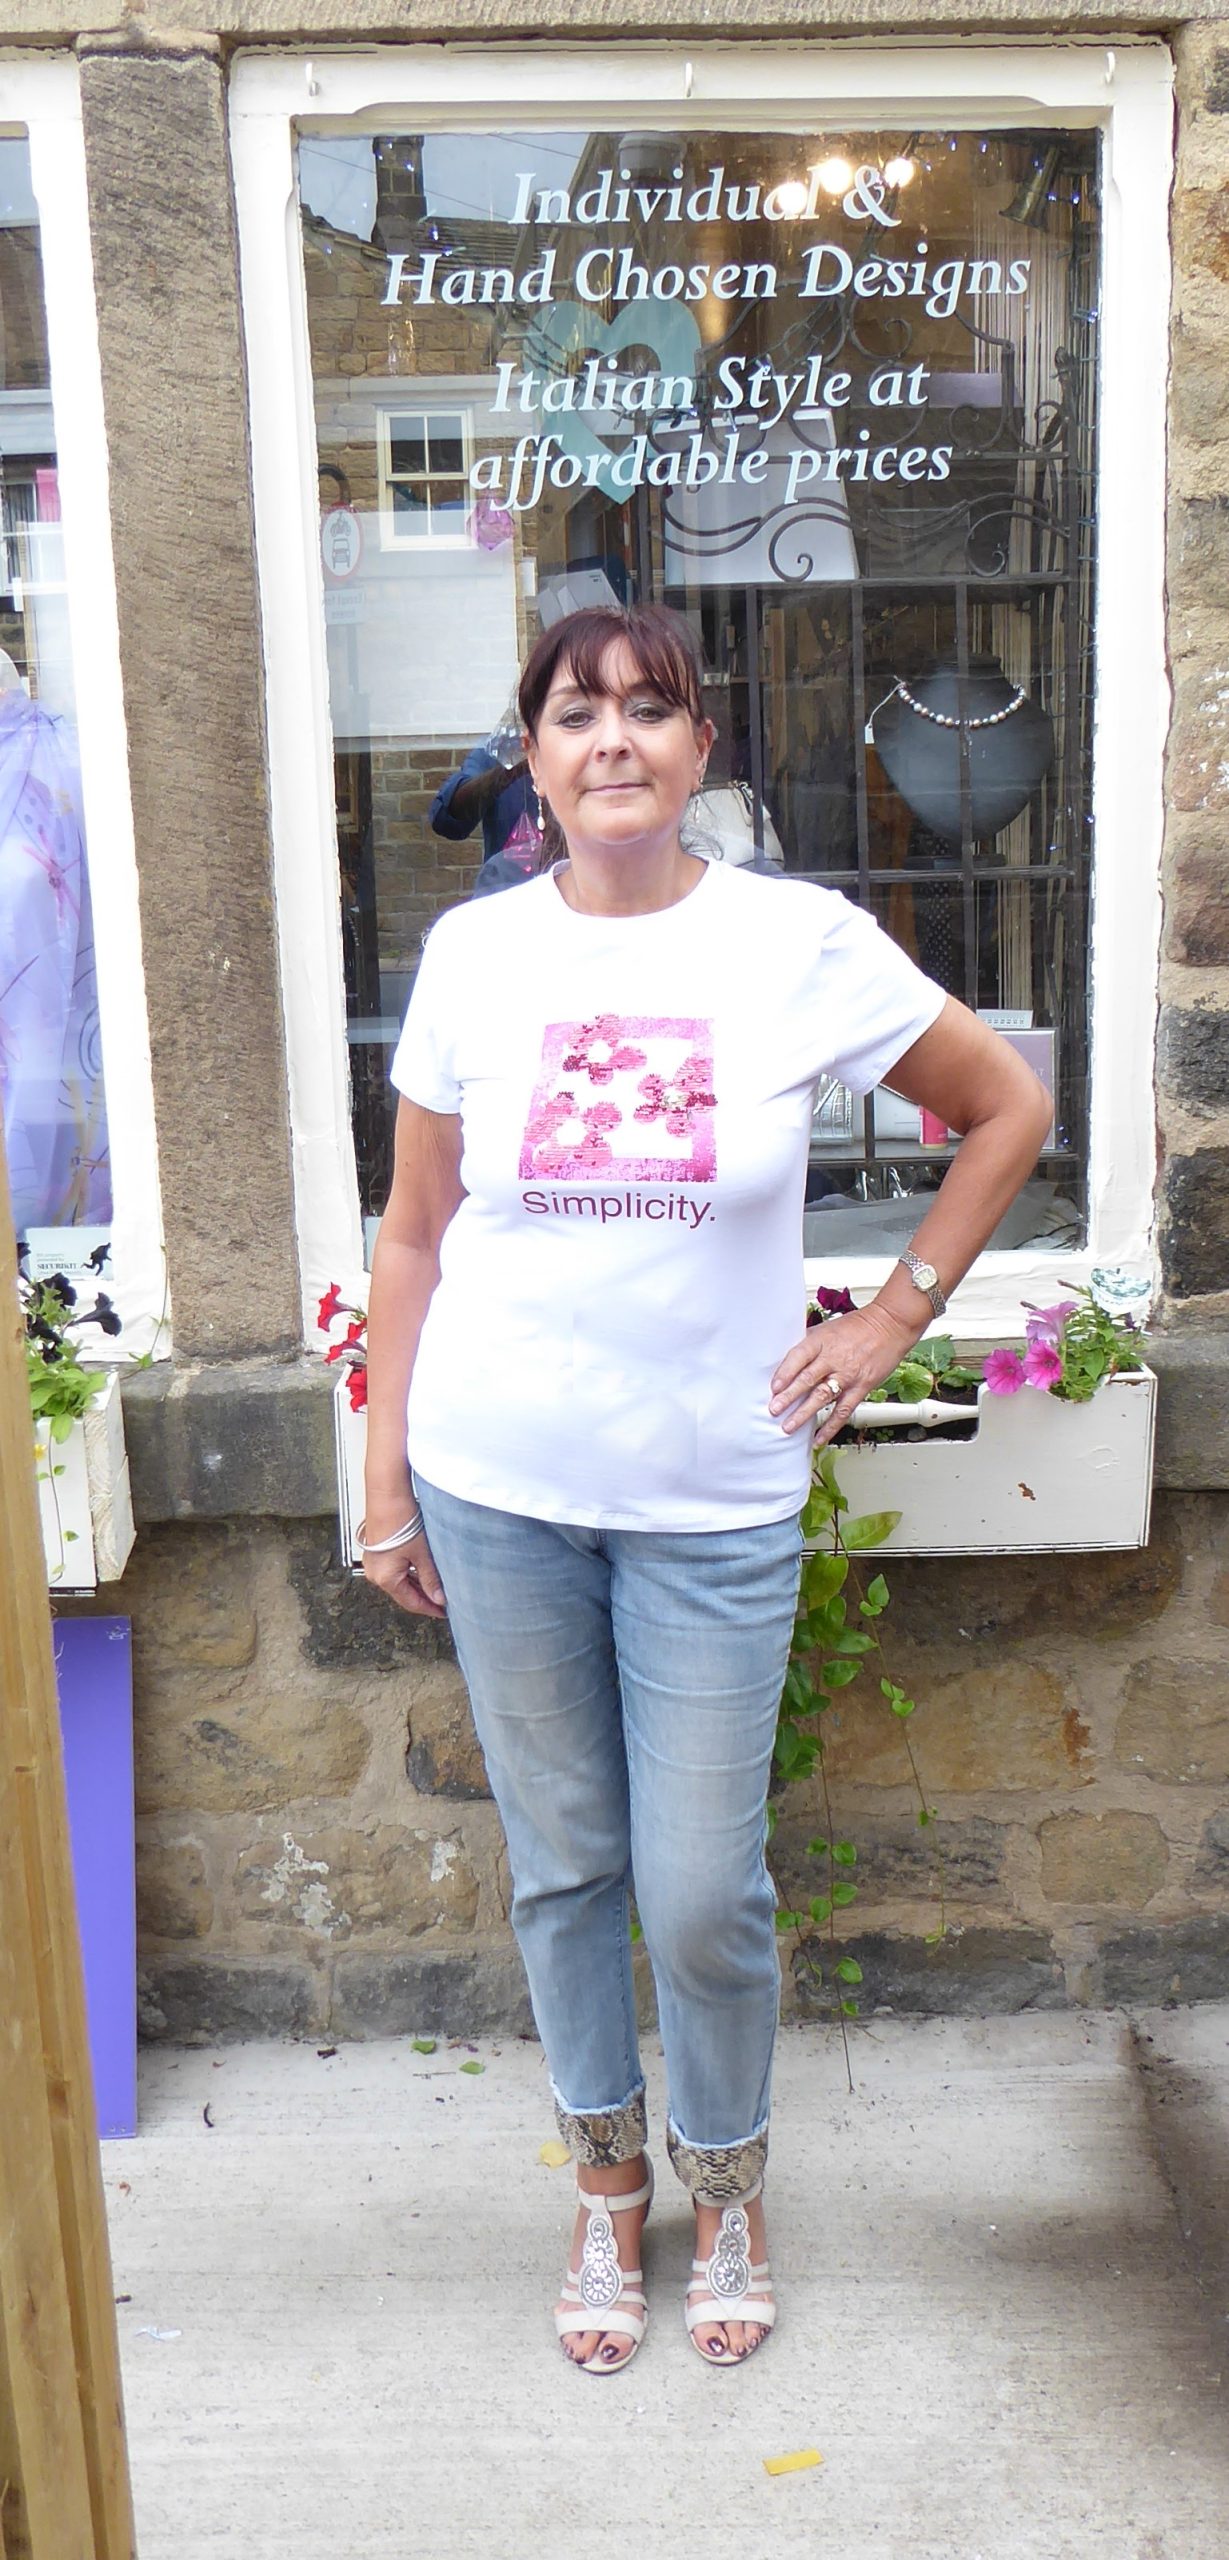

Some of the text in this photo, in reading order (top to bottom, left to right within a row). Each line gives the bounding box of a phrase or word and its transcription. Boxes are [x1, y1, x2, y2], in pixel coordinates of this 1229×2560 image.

[508, 165, 901, 227] Individual &
[381, 242, 1031, 318] Hand Chosen Designs
[489, 355, 930, 430] Italian Style at
[469, 429, 952, 511] affordable prices
[522, 1191, 715, 1229] Simplicity.
